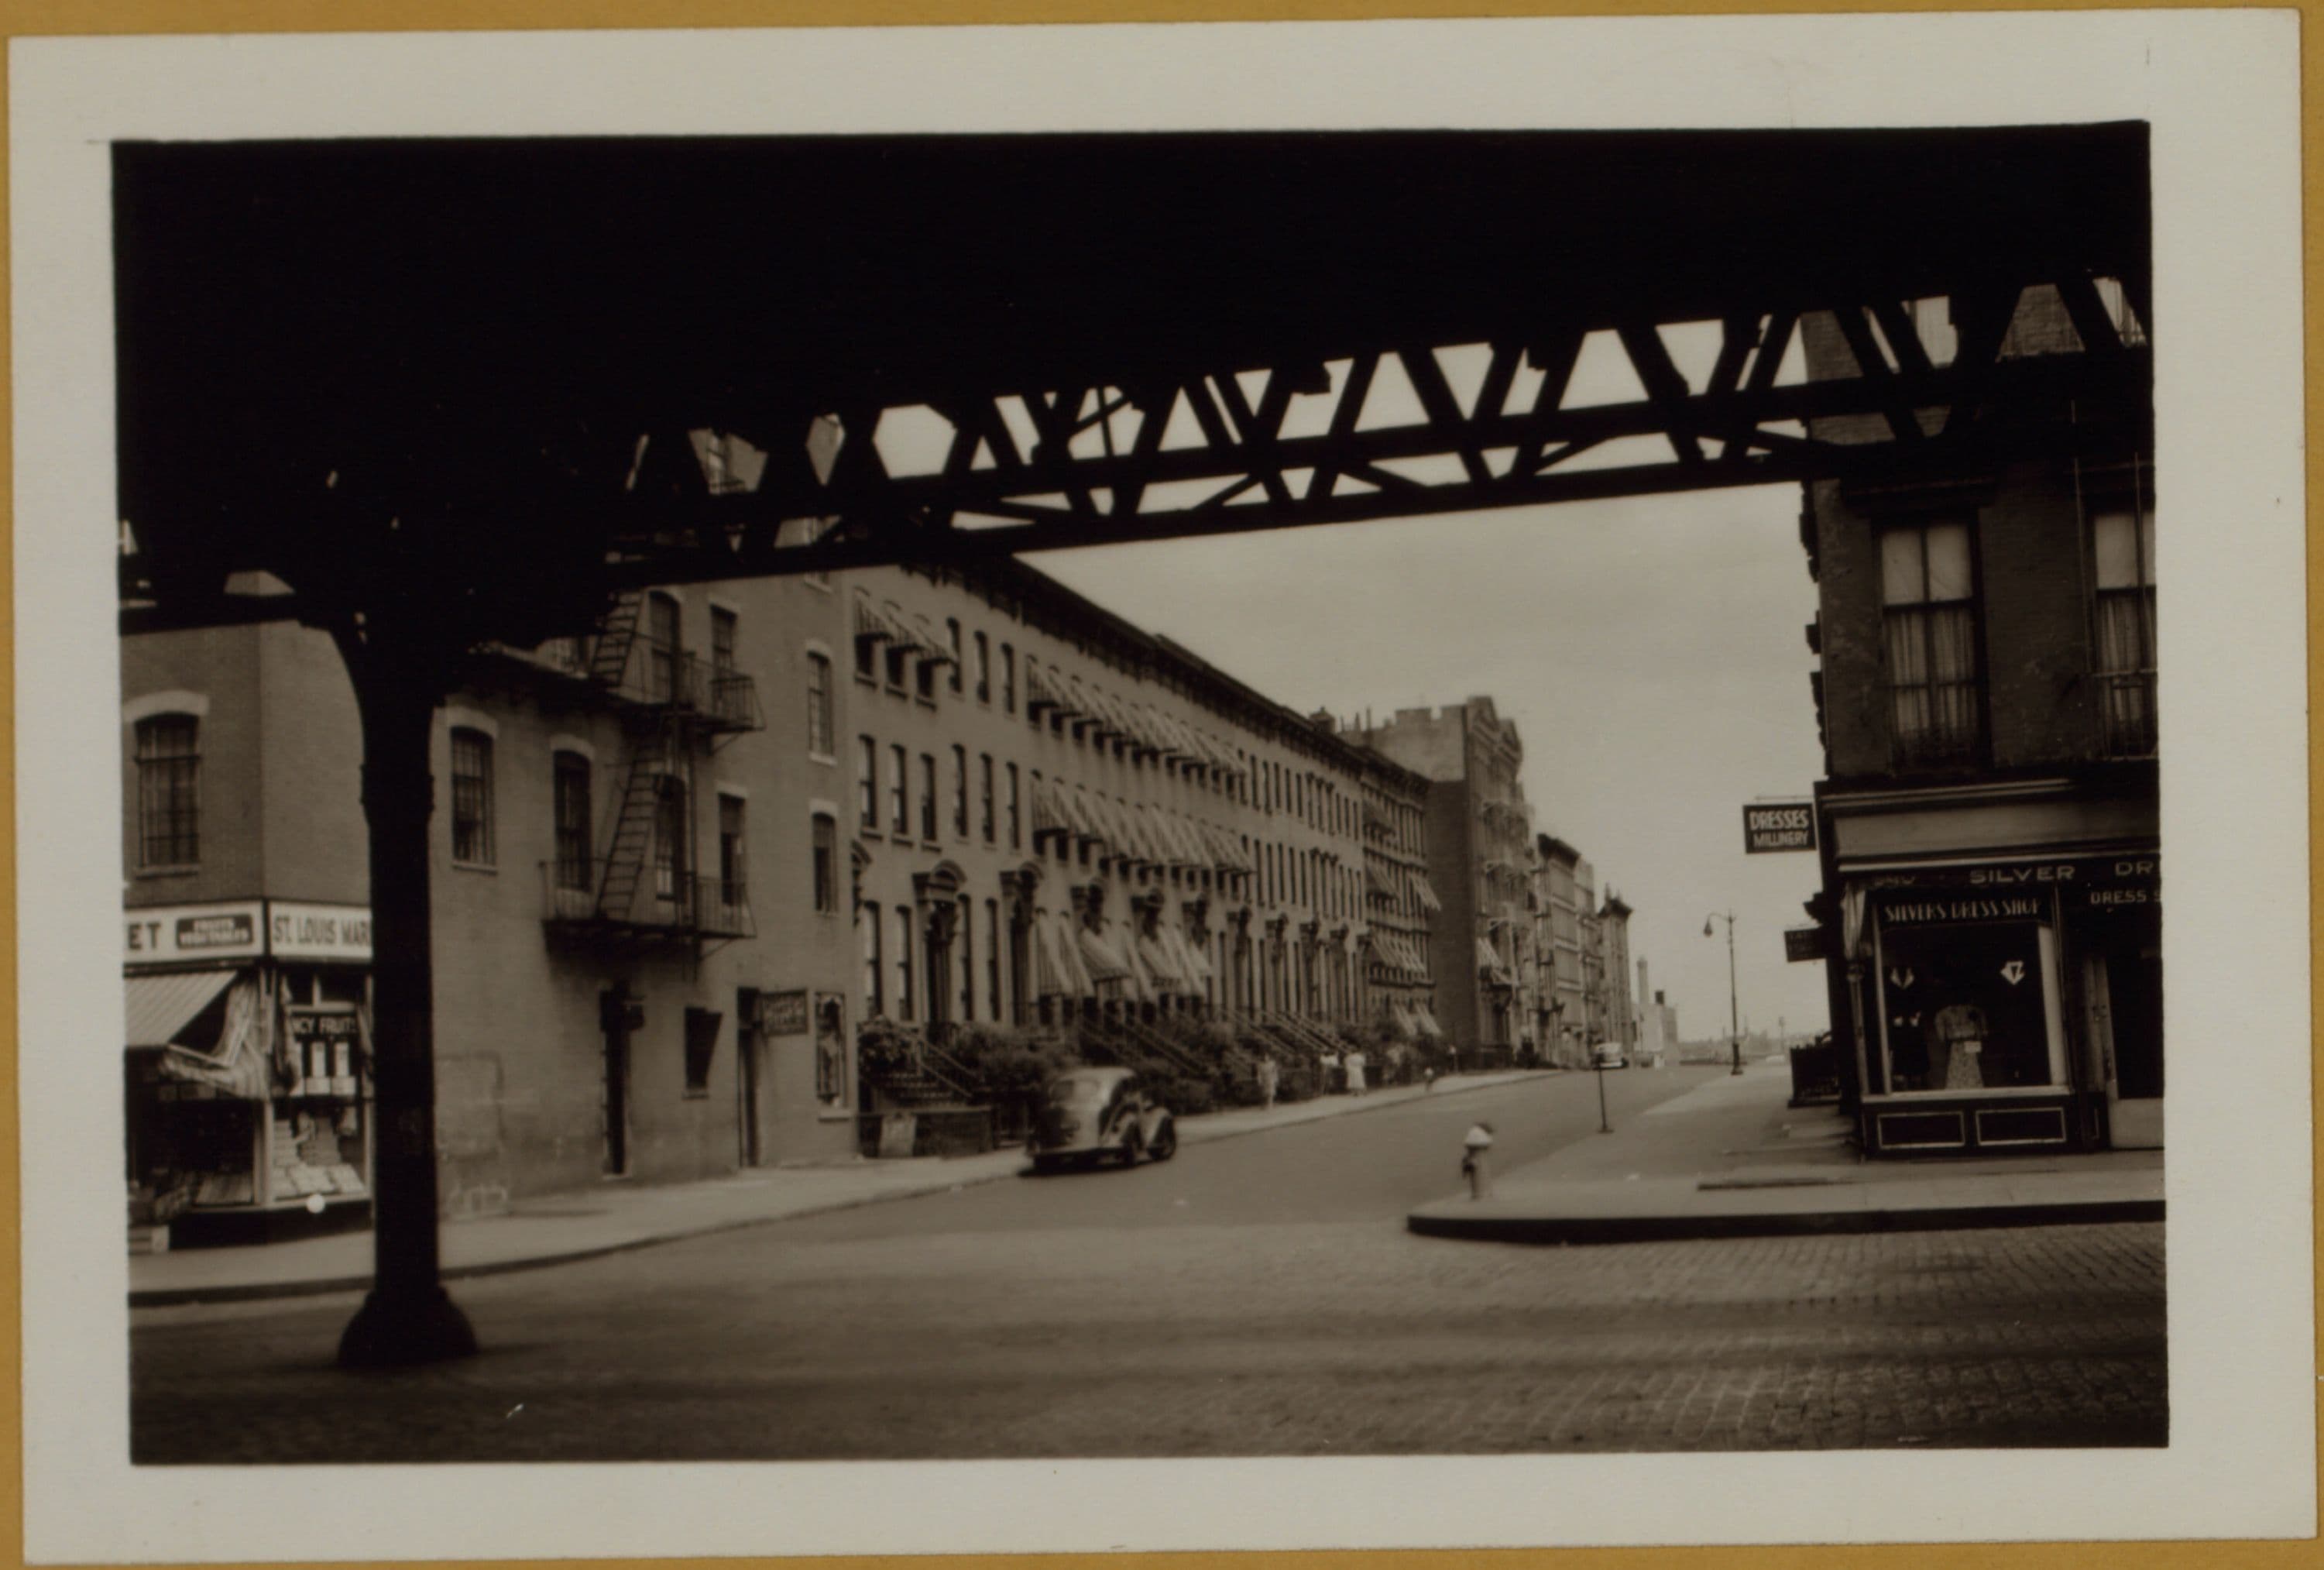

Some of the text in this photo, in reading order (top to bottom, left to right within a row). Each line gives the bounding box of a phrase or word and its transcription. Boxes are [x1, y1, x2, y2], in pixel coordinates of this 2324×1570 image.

[1749, 809, 1810, 831] DRESSES
[1752, 830, 1809, 849] MILLINERY
[1969, 864, 2076, 885] SILVER
[1950, 898, 2000, 919] DRESS
[2001, 896, 2041, 916] SHOP
[2090, 890, 2147, 905] DRESS
[297, 917, 336, 945] LOUIS
